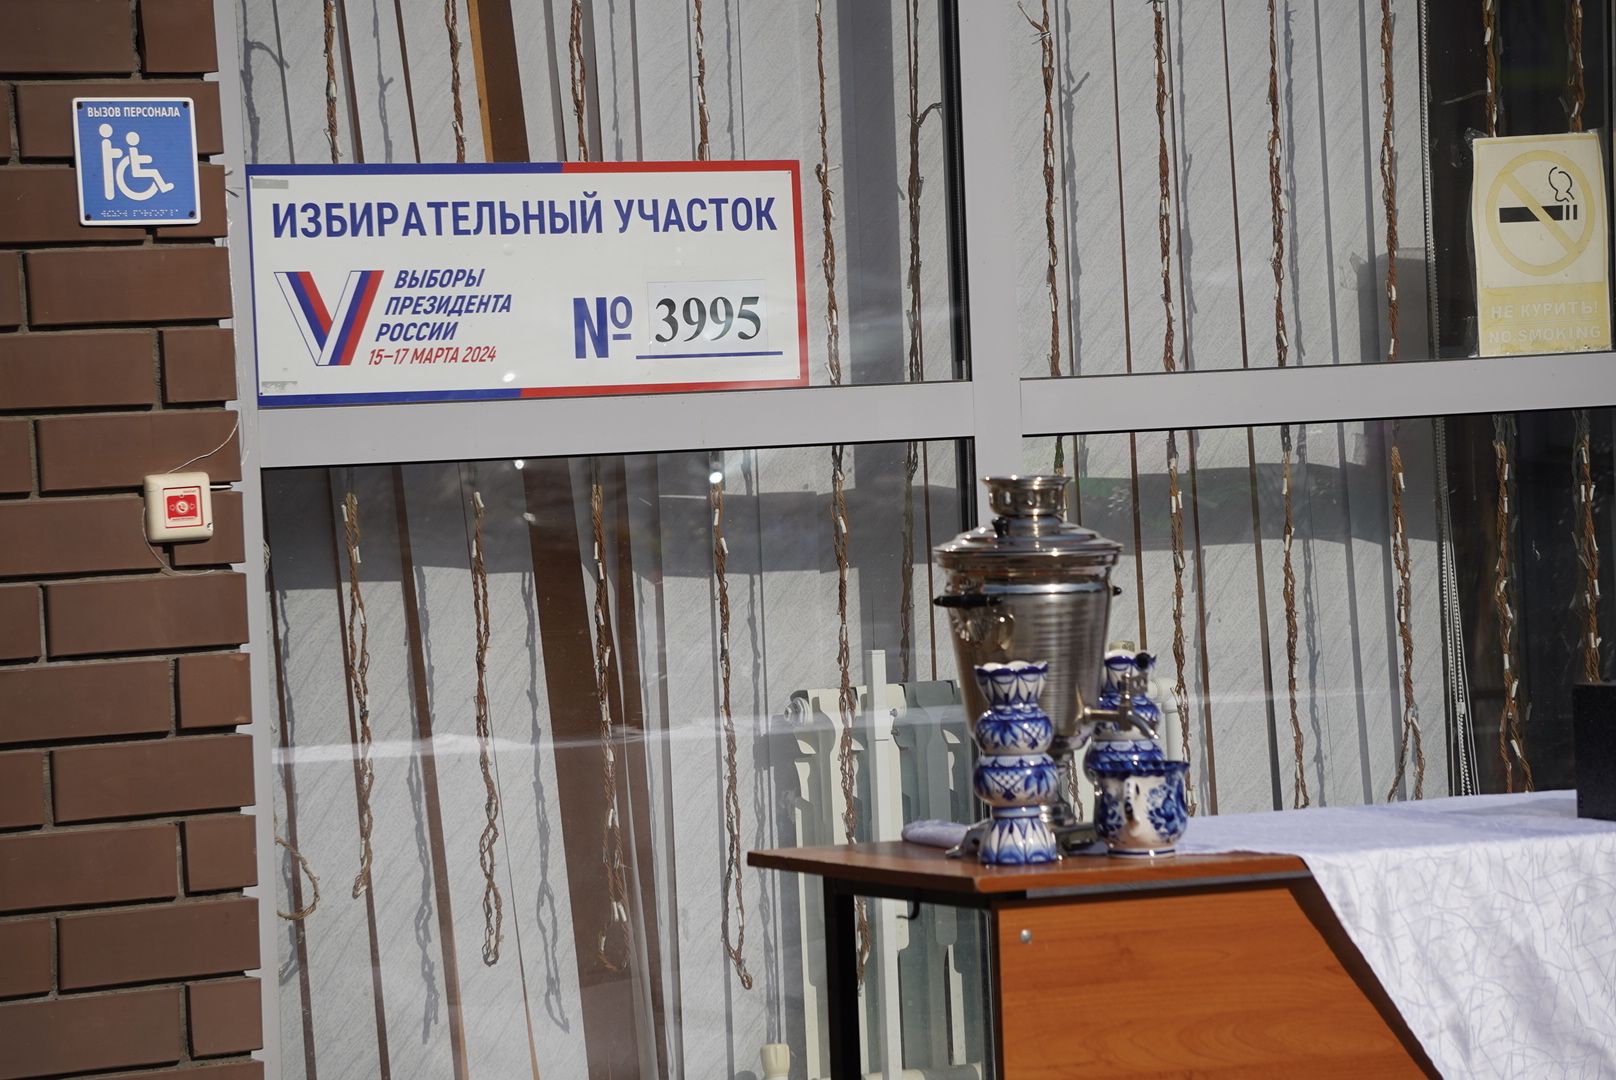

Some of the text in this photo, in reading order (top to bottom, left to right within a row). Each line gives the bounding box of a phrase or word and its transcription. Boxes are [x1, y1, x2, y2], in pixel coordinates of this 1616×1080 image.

[87, 106, 181, 118] ВЫЗОВ ПЕРСОНАЛА
[271, 190, 778, 239] ИЗБИРАТЕЛЬНЫЙ УЧАСТОК
[393, 268, 486, 289] ВЫБОРЫ
[384, 293, 512, 318] ПРЕЗИДЕНТА
[1490, 304, 1514, 320] НЕ
[654, 295, 762, 343] 3995
[375, 321, 459, 343] РОССИИ
[1487, 325, 1601, 344] NO SMOKING
[411, 347, 460, 365] МАРТА
[461, 345, 497, 364] 2024
